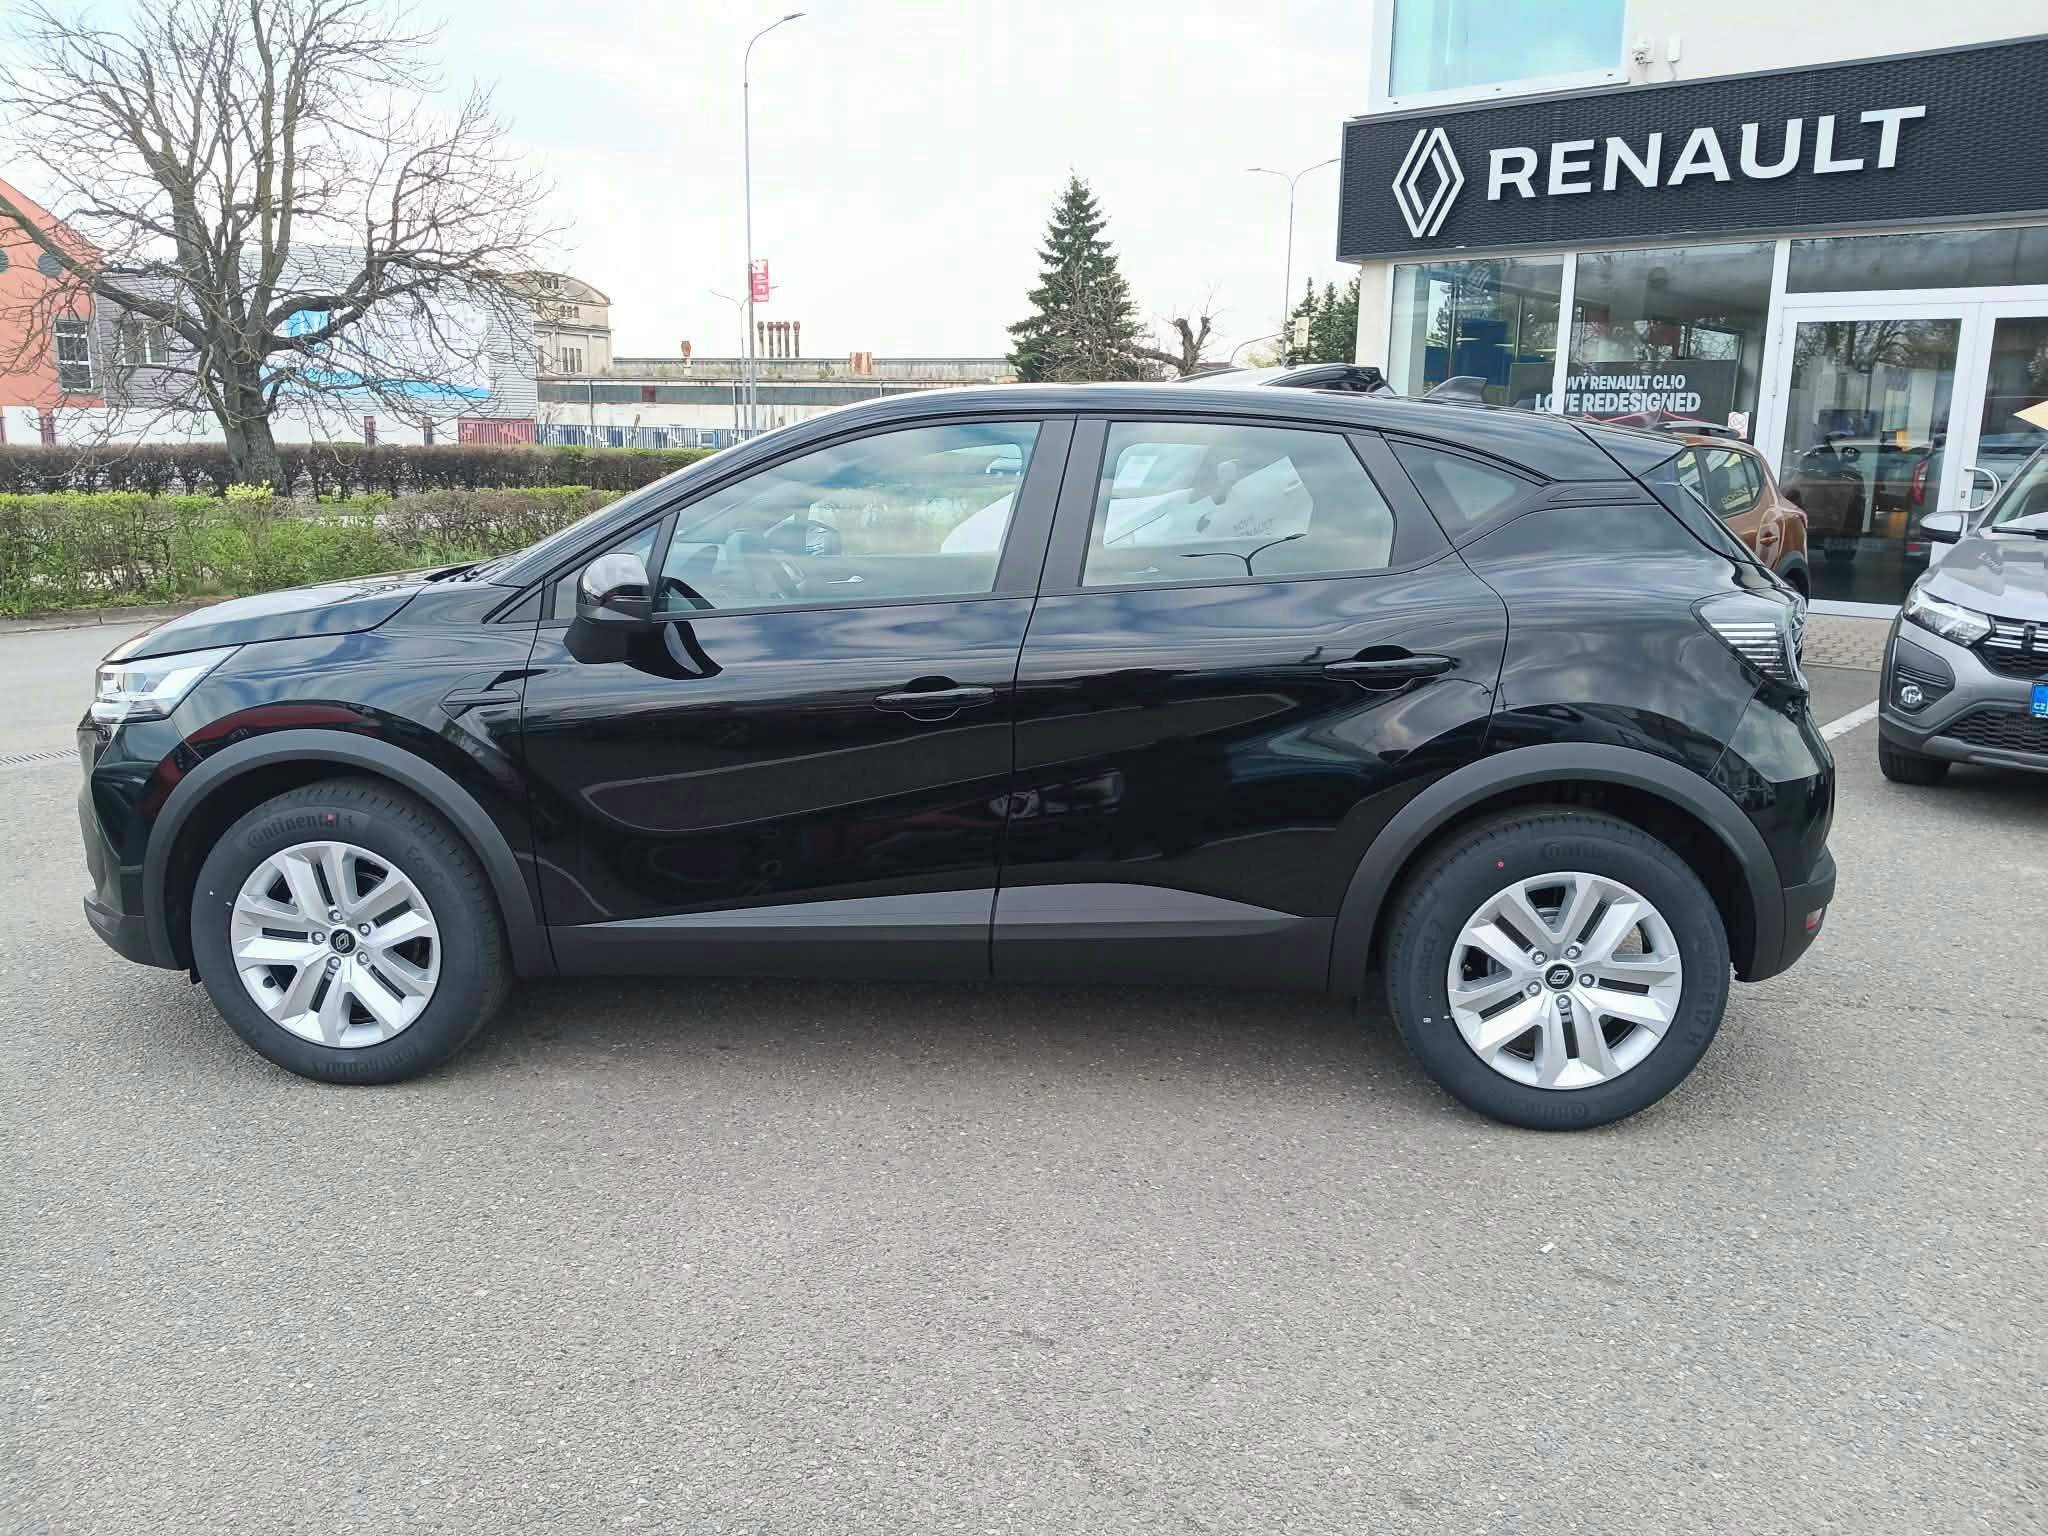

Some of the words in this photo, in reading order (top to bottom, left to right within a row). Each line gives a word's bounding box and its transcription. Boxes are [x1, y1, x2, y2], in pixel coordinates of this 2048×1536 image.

[1487, 106, 1926, 201] RENAULT
[1558, 373, 1590, 391] VÝ
[1590, 374, 1652, 391] RENAULT
[1653, 374, 1687, 390] CLIO
[1582, 391, 1702, 413] REDESIGNED
